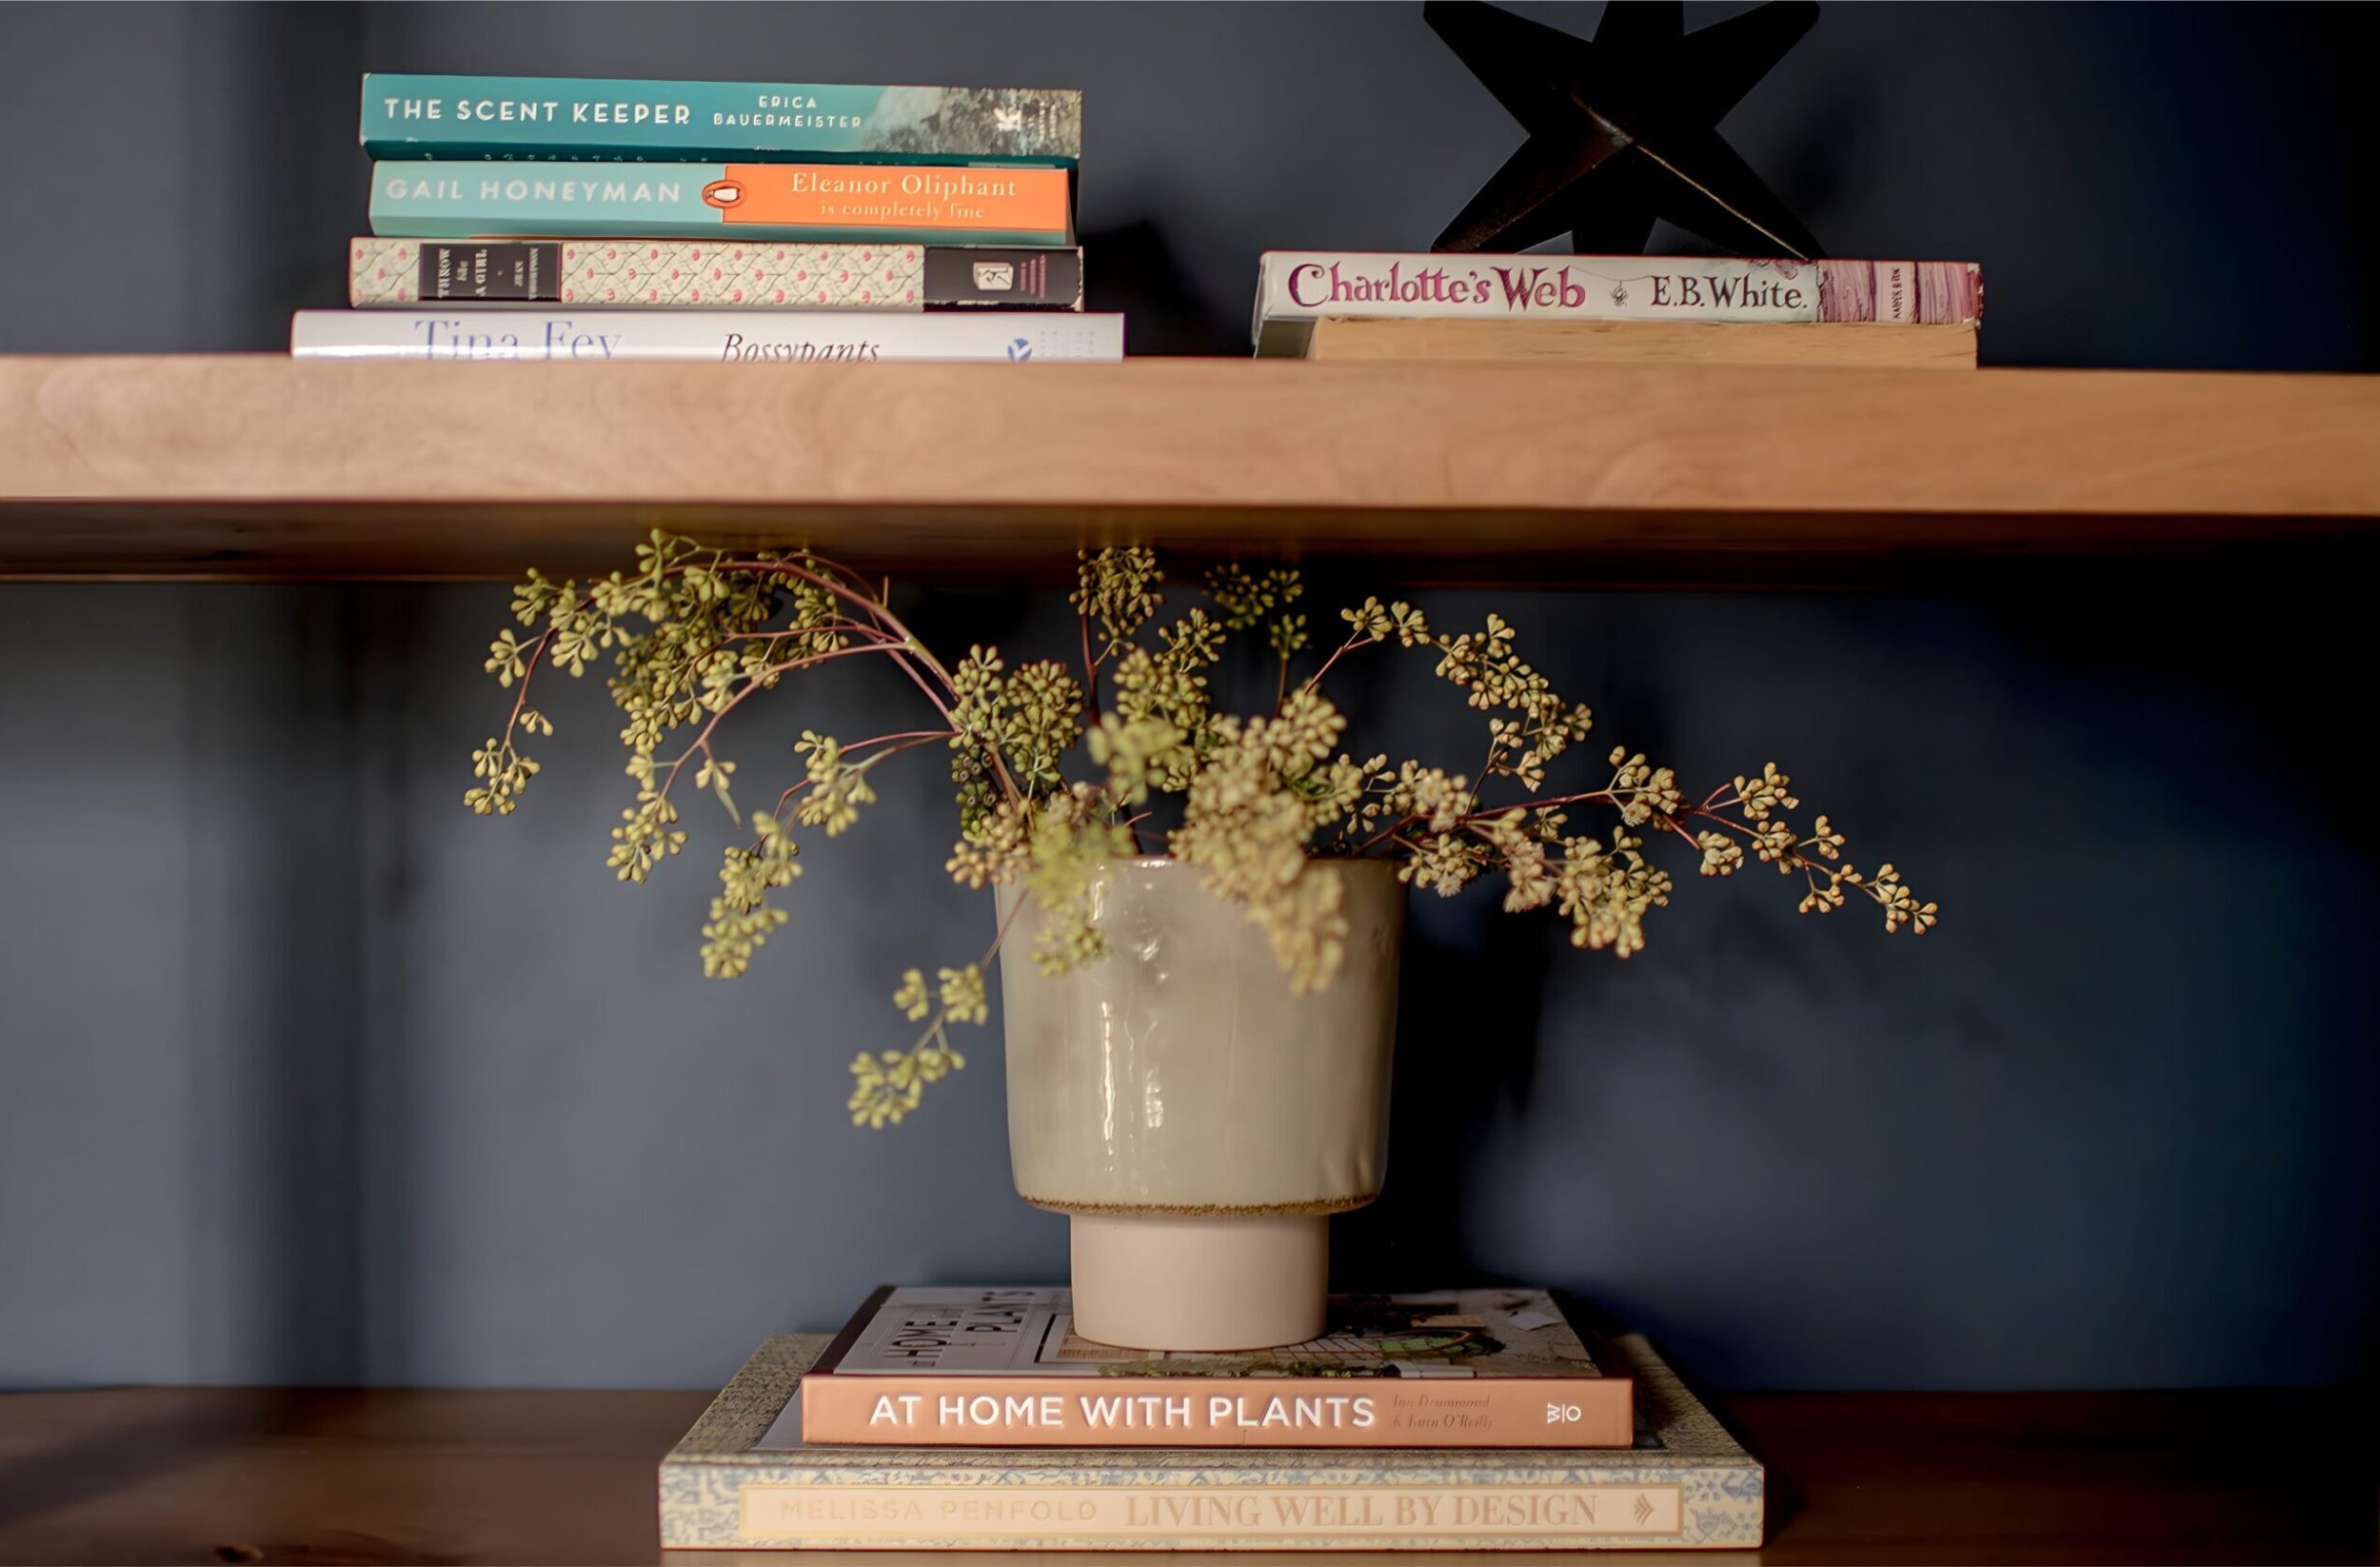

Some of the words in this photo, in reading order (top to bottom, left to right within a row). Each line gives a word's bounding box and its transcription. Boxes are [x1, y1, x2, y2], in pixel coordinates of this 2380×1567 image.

[385, 97, 443, 120] THE
[456, 100, 560, 123] SCENT
[573, 103, 692, 126] KEEPER
[758, 94, 817, 109] ERICA
[713, 111, 862, 129] BAUERMEISTER
[385, 178, 464, 200] GAIL
[480, 179, 681, 204] HONEYMAN
[791, 171, 891, 194] Eleanor
[901, 173, 1017, 202] Oliphant
[820, 199, 835, 215] is
[842, 200, 942, 222] completely
[949, 202, 985, 219] fine
[475, 248, 488, 285] GIRL
[1286, 260, 1492, 308] Charlotte's
[1489, 264, 1587, 312] Web
[414, 320, 520, 360] Tina
[542, 320, 624, 361] Fey
[721, 332, 881, 364] Bossypants
[883, 1319, 960, 1359] HOME
[868, 1395, 922, 1426] AT
[938, 1395, 1063, 1426] HOME
[1079, 1396, 1191, 1427] WITH
[1209, 1396, 1377, 1428] PLANTS
[779, 1498, 923, 1521] MELISSA
[940, 1499, 1098, 1522] PENFOLD
[1124, 1495, 1262, 1527] LIVING
[1267, 1495, 1384, 1527] WELL
[1394, 1495, 1445, 1527] BY
[1454, 1495, 1599, 1527] DESIGN
